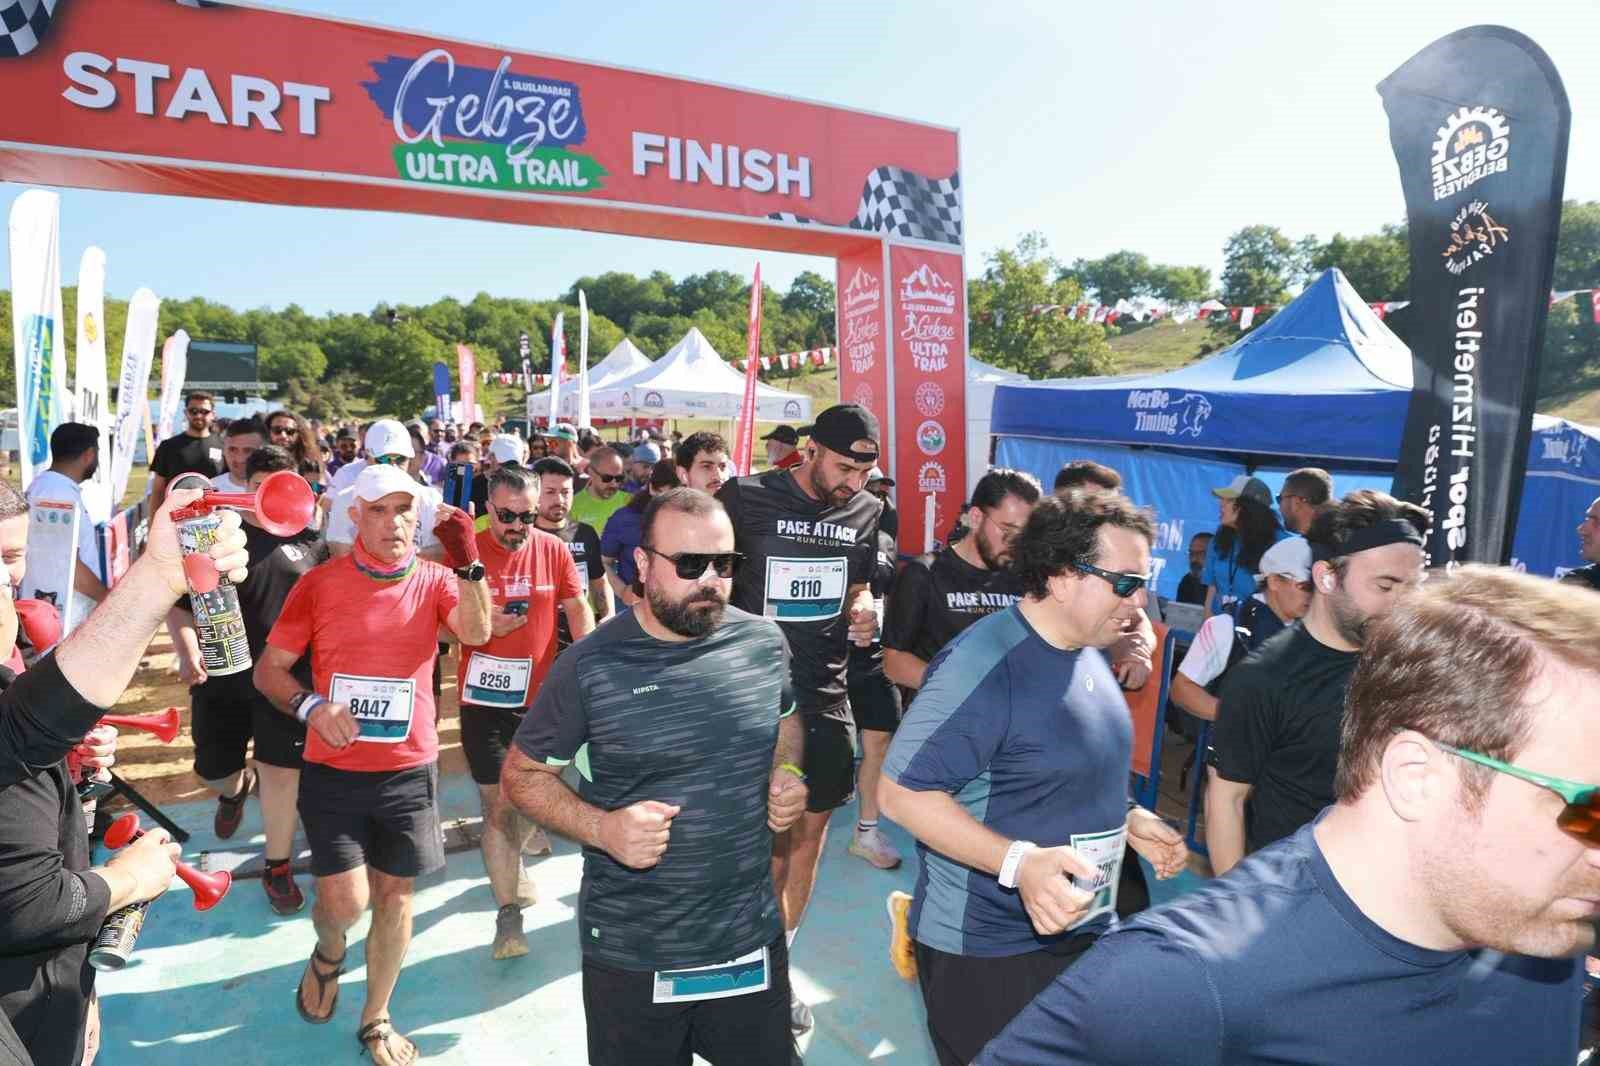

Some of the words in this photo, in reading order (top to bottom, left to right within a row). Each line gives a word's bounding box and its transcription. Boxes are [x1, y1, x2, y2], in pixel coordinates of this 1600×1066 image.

[62, 51, 331, 136] START
[393, 48, 578, 158] Gebze
[406, 152, 498, 183] ULTRA
[507, 157, 588, 187] TRAIL
[632, 131, 811, 199] FINISH
[909, 340, 949, 357] ULTRA
[913, 355, 949, 373] TRAIL
[1127, 389, 1170, 409] MerBe
[1134, 410, 1179, 436] Timing
[776, 519, 811, 536] PACE
[813, 522, 858, 543] ATTACK
[790, 579, 822, 598] 8110
[946, 591, 979, 608] PACE
[479, 671, 511, 689] 8258
[632, 684, 660, 695] KIPSTA
[350, 698, 391, 718] 8447
